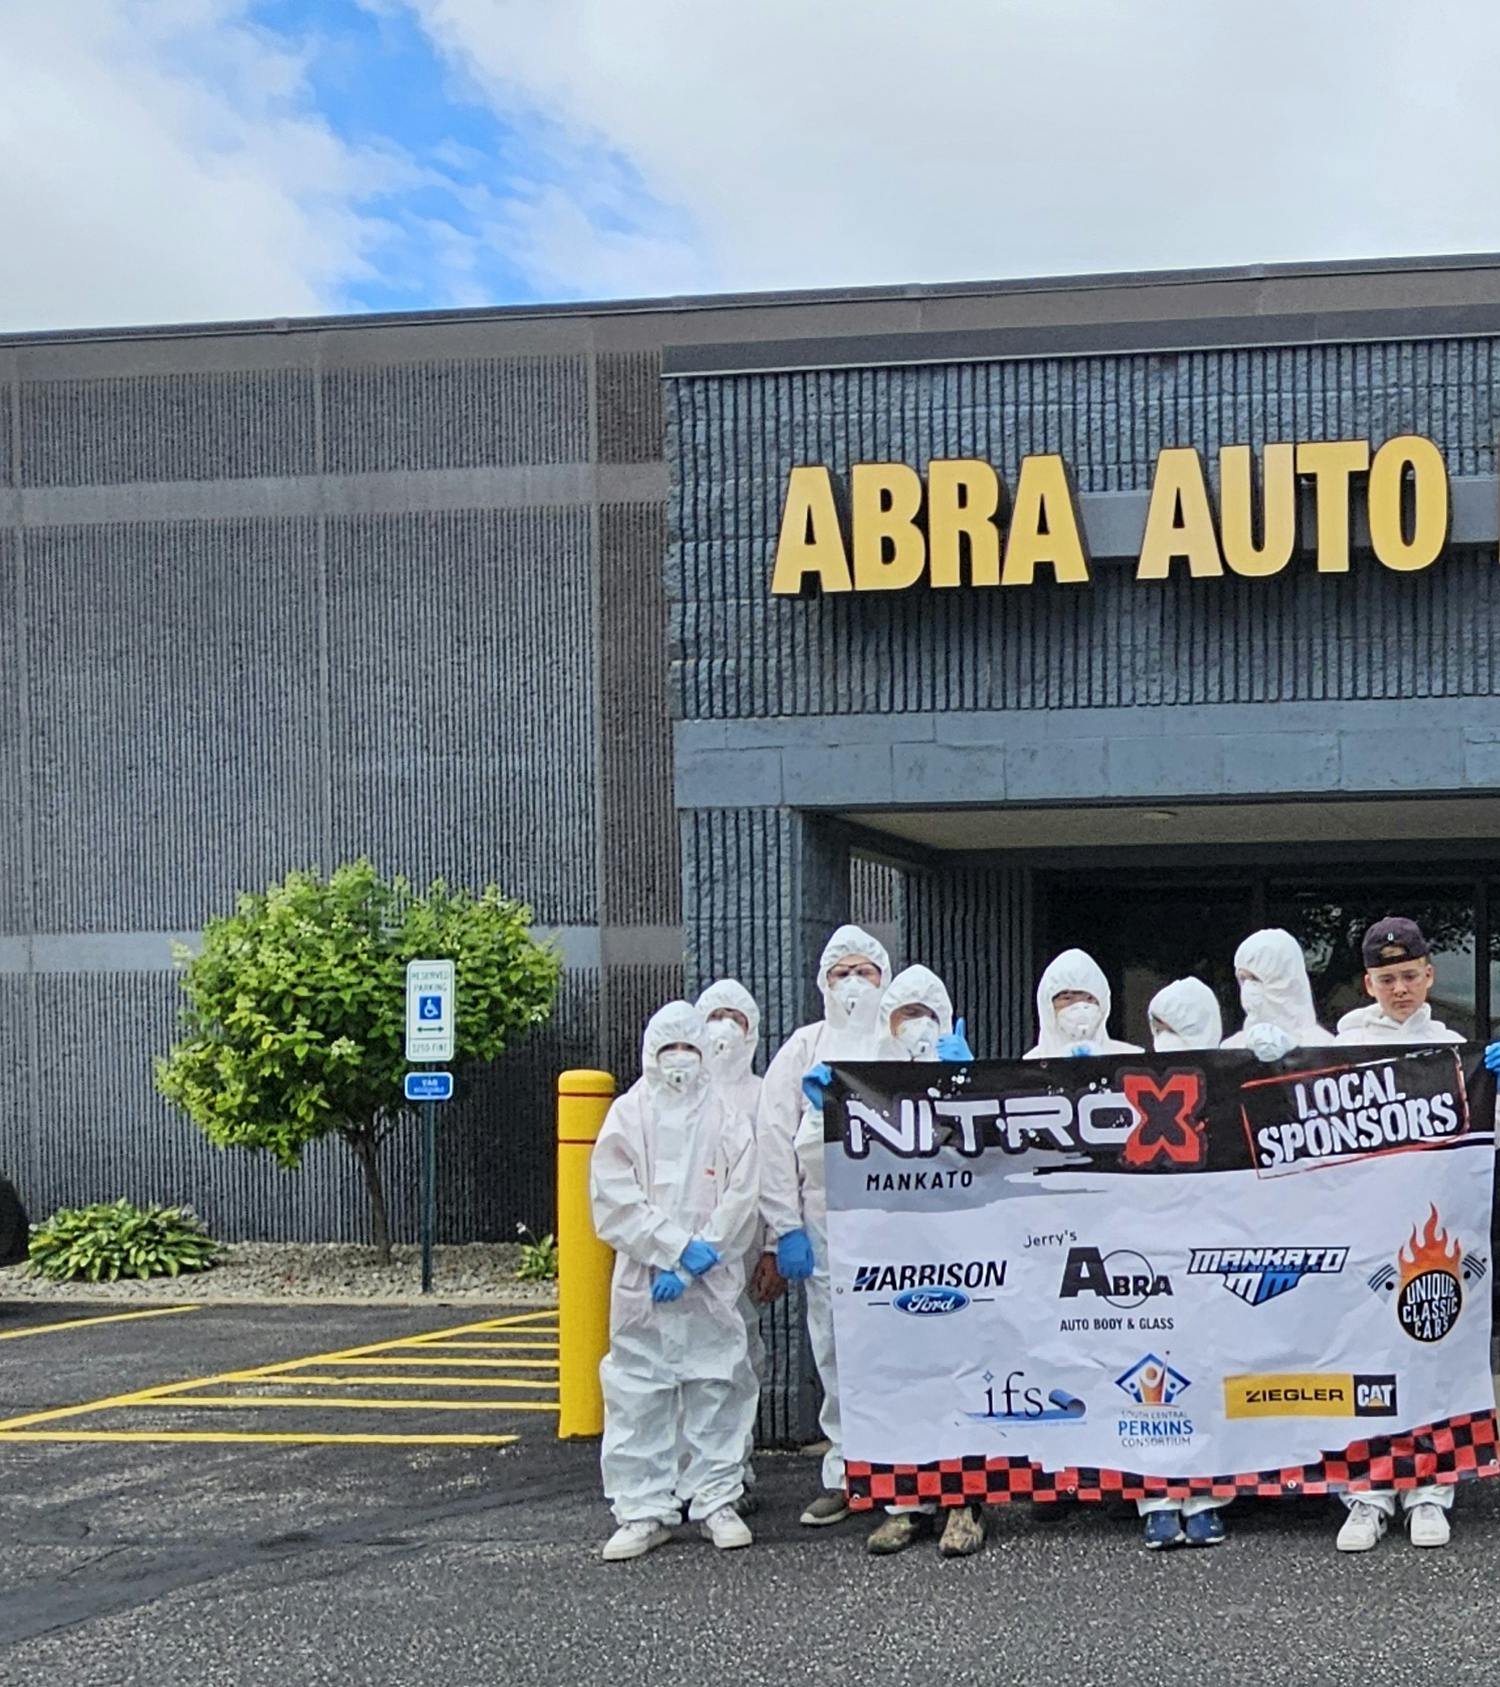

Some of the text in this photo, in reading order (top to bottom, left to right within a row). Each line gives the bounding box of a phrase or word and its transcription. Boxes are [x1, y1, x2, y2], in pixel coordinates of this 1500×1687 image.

[770, 453, 1090, 594] ABRA
[1136, 435, 1448, 580] AUTO
[1293, 1066, 1406, 1120] LOCAL
[845, 1073, 1201, 1166] NITROX
[1257, 1092, 1458, 1167] SPONSORS
[866, 1169, 974, 1191] MANKATO
[1023, 1230, 1078, 1248] Jerry's
[1059, 1246, 1174, 1298] ABRA
[1189, 1248, 1348, 1273] MANKATO
[853, 1260, 1008, 1292] HARRISON
[1406, 1272, 1457, 1305] UNIQUE
[907, 1291, 956, 1313] Ford
[1402, 1297, 1458, 1323] CLASSIC
[1060, 1317, 1175, 1332] AUTO BODY & GLASS
[1414, 1315, 1449, 1339] CARS
[984, 1370, 1044, 1418] ifs
[1245, 1384, 1395, 1408] ZIEGLER CAT
[1151, 1410, 1188, 1419] CENTRAL
[1118, 1419, 1194, 1436] PERKINS
[1121, 1437, 1191, 1448] CONSORTIUM
